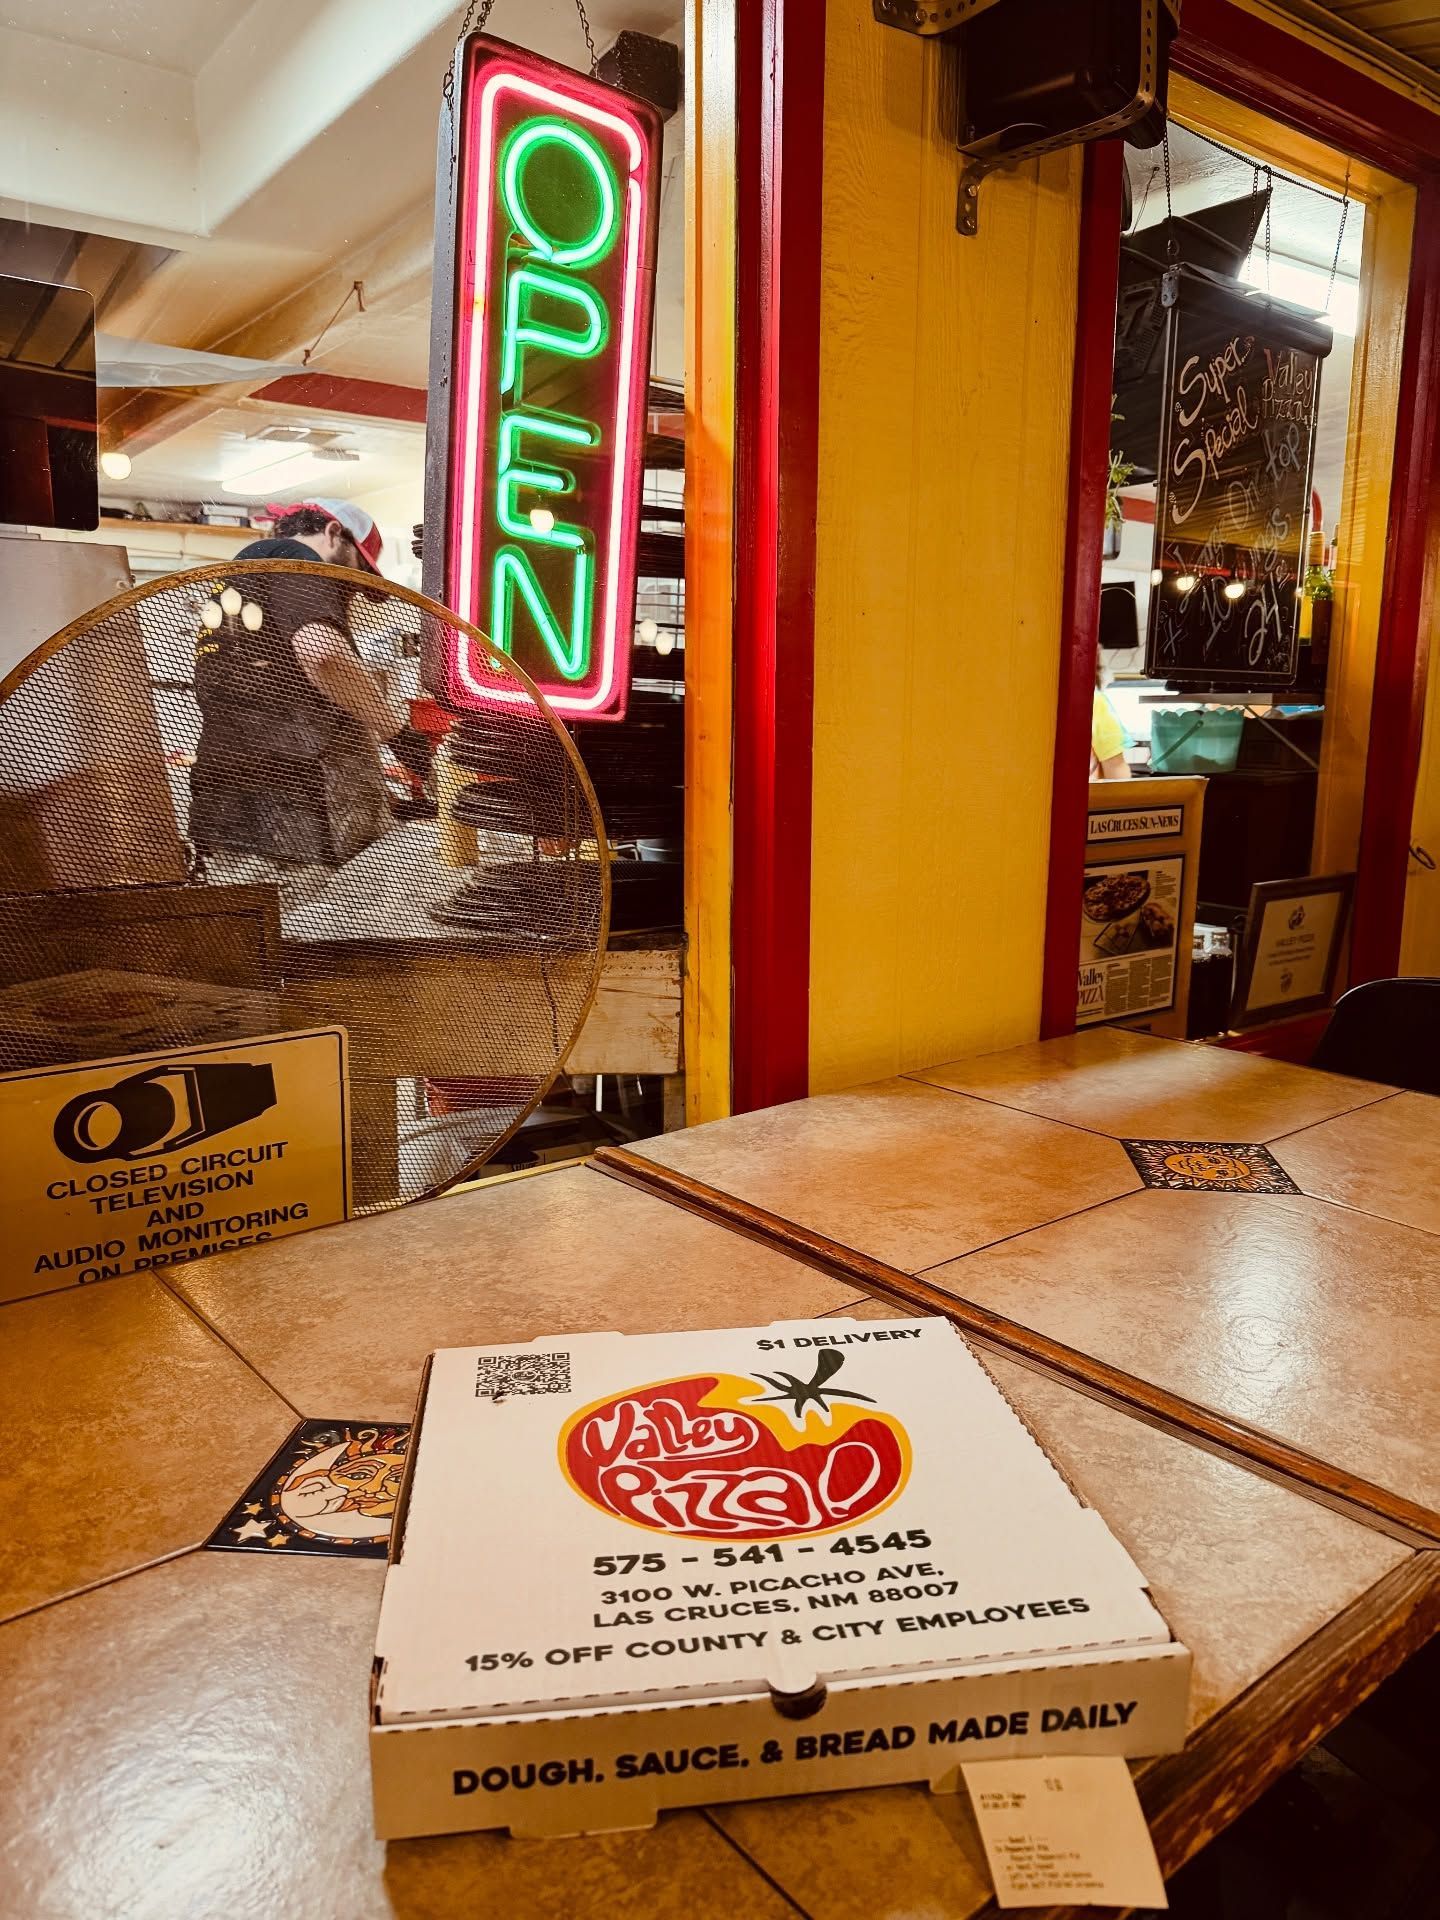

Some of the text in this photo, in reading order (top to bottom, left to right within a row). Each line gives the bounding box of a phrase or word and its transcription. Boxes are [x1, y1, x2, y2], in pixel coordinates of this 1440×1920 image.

[492, 117, 620, 679] OPEN
[1179, 336, 1242, 427] Super
[1263, 348, 1314, 408] Valley
[1172, 385, 1259, 525] Special
[1090, 820, 1107, 834] LAS
[1107, 817, 1139, 832] CRUCES
[46, 1141, 289, 1200] CLOSED CIRCUIT
[88, 1169, 254, 1215] TELEVISION
[32, 1202, 309, 1274] AUDIO MONITORING
[146, 1201, 205, 1228] AND
[78, 1263, 121, 1284] ON
[756, 1328, 922, 1351] $1 DELIVERY
[582, 1399, 759, 1467] Valley
[593, 1553, 666, 1576] 575
[713, 1544, 784, 1567] 541
[829, 1528, 932, 1556] 4545
[593, 1580, 959, 1628] LAS CRUCES, NM 88007
[601, 1587, 673, 1605] 3100
[682, 1583, 721, 1598] W.
[730, 1571, 866, 1595] PICACHO
[465, 1597, 1090, 1672] 15% OFF COUNTY & CITY EMPLOYEES
[453, 1701, 1138, 1796] DOUGH, SAUCE, & BREAD MADE DAILY
